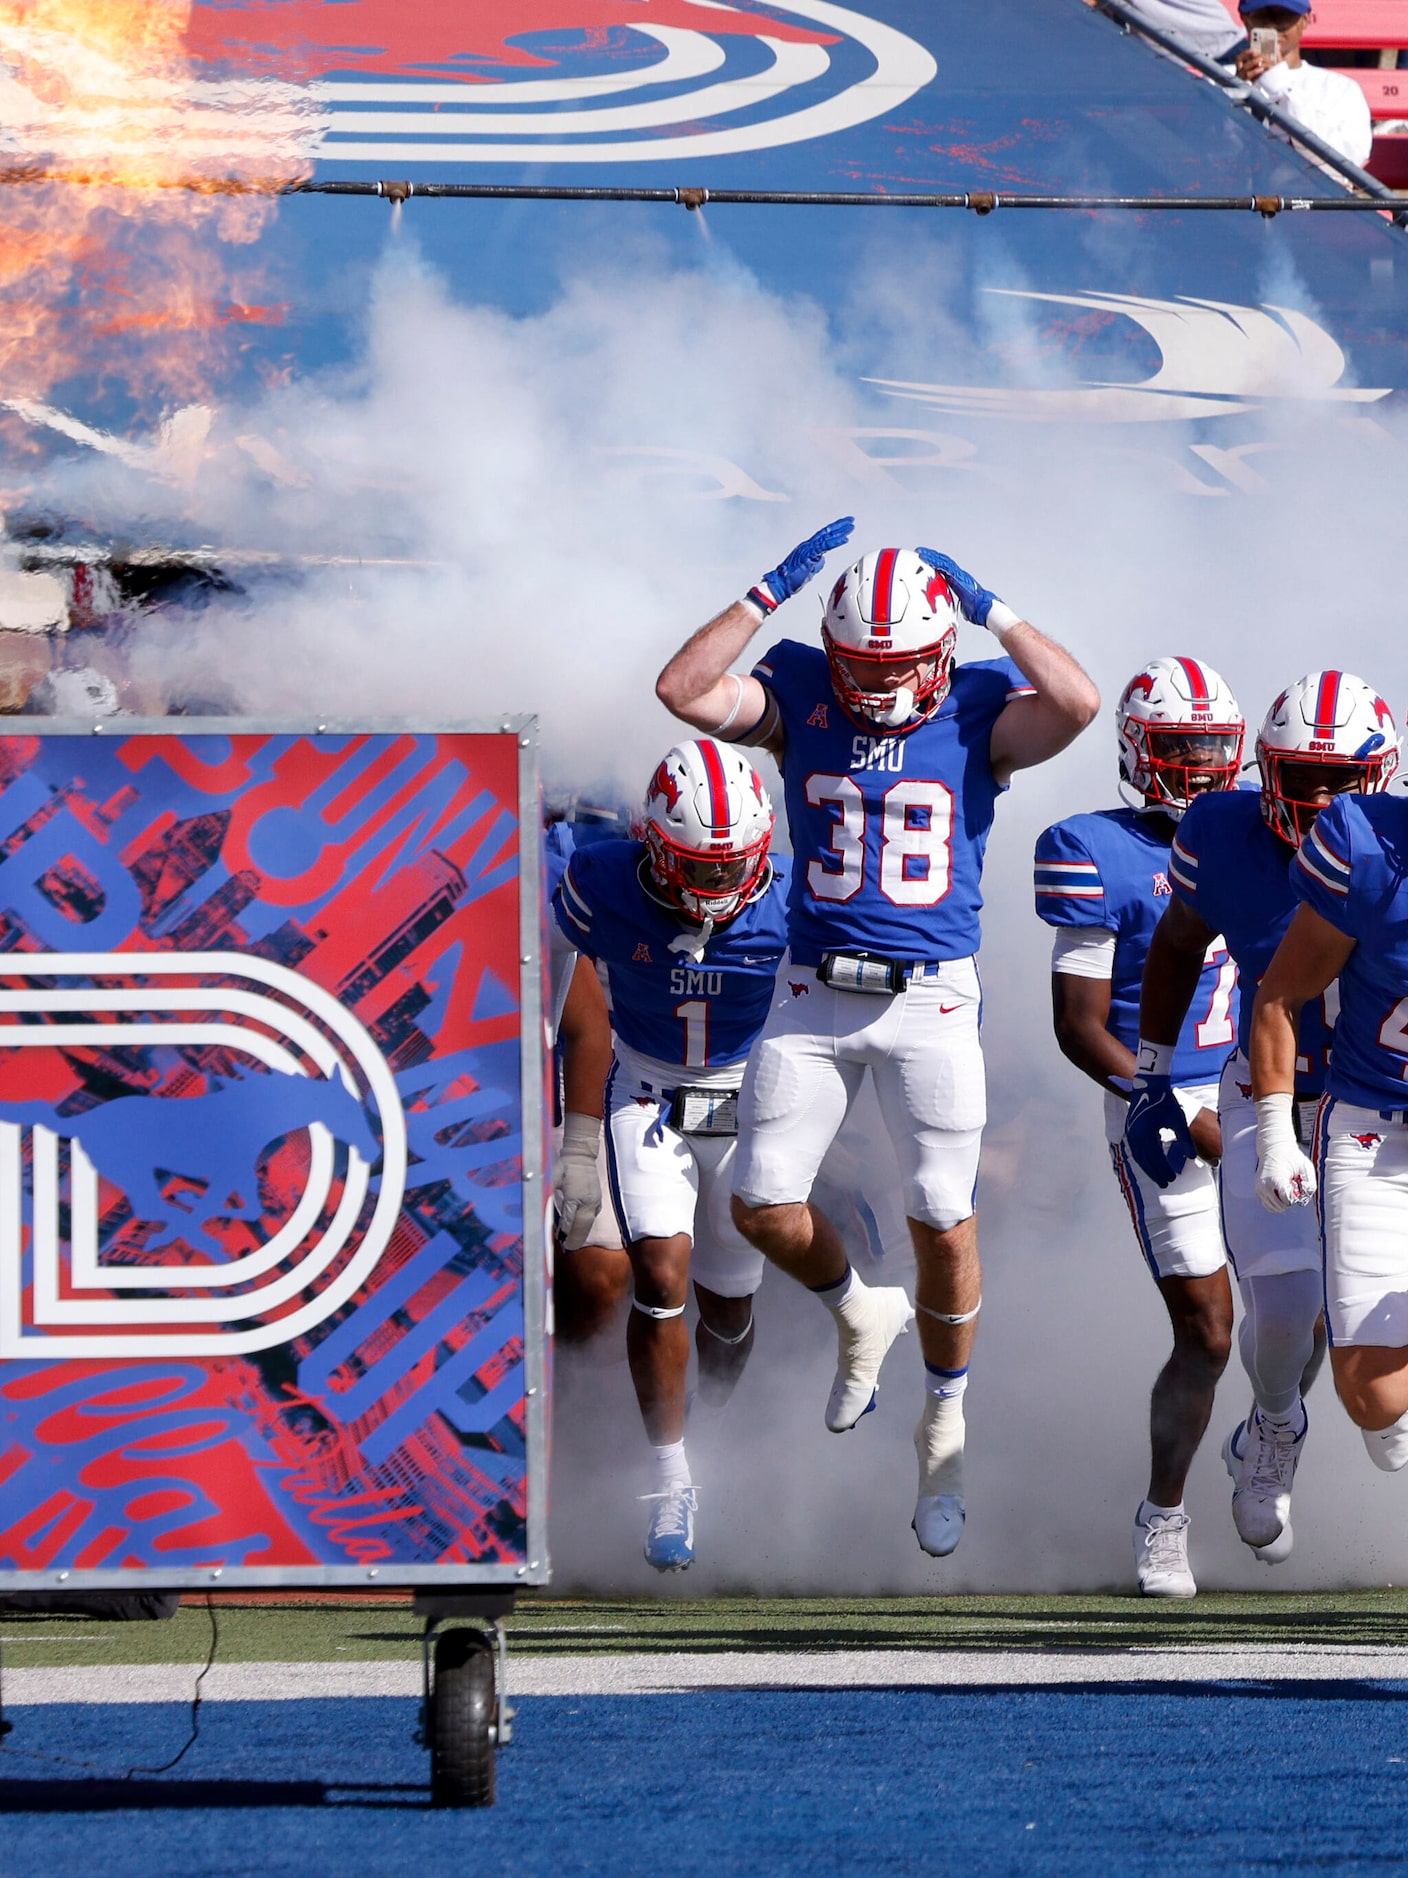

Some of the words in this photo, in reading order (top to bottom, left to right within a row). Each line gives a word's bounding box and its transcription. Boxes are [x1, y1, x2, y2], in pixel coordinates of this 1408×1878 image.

[1382, 86, 1399, 97] 20
[868, 639, 893, 650] SMU
[1191, 713, 1214, 722] SMU
[1309, 741, 1336, 752] SMU
[850, 736, 905, 773] SMU
[803, 772, 956, 908] 38
[709, 842, 734, 851] SMU
[669, 969, 723, 996] SMU
[674, 999, 711, 1068] 1
